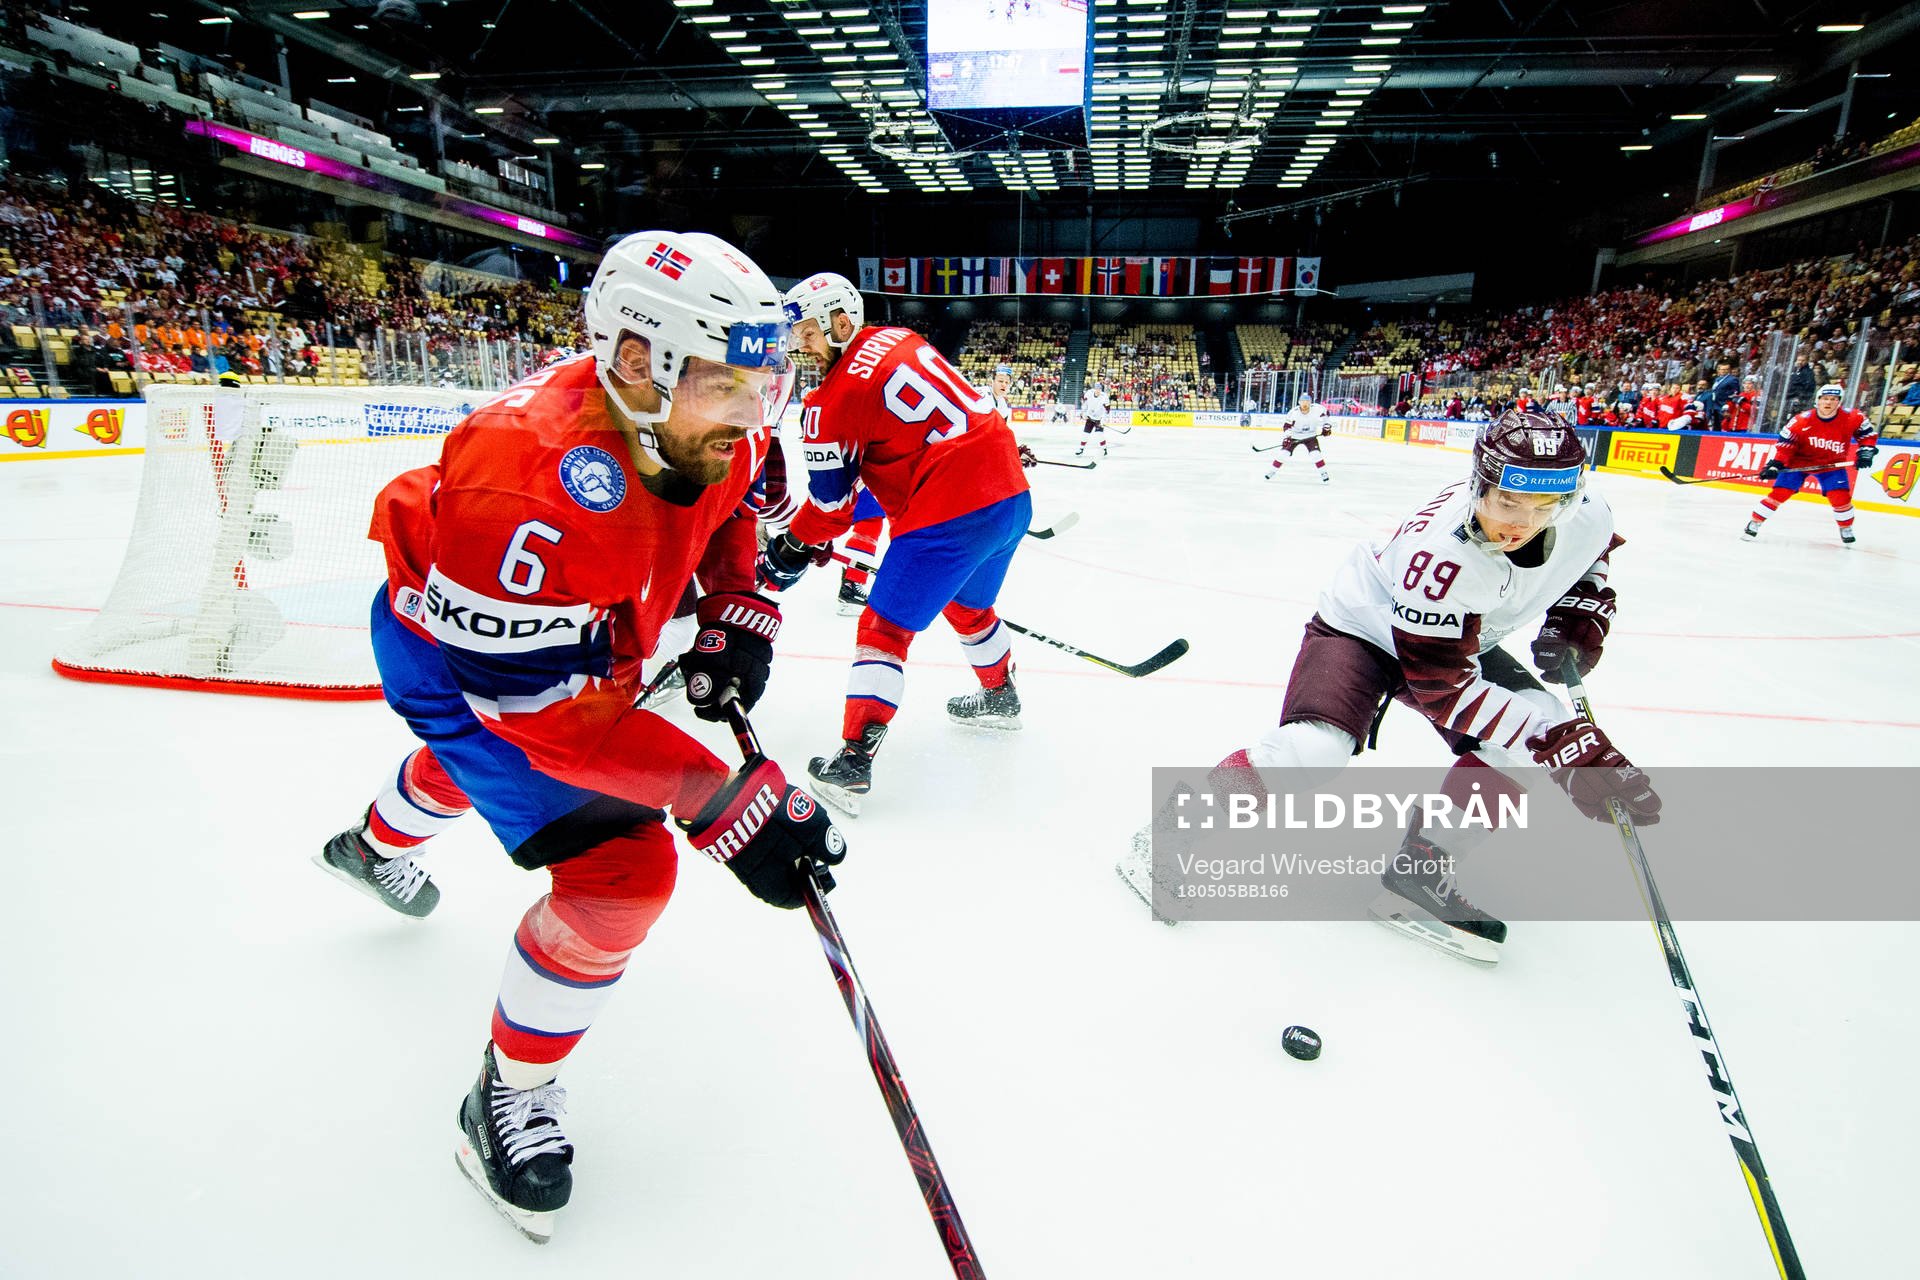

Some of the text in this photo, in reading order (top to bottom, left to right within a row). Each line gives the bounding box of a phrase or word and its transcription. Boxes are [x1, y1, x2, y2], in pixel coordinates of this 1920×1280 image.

[250, 136, 306, 168] HEROES
[620, 305, 661, 328] CCM
[883, 345, 996, 445] 90
[803, 451, 839, 462] ODA
[1532, 438, 1557, 456] 89
[1613, 439, 1671, 465] PIRELLI
[1809, 436, 1846, 454] NORGE
[498, 519, 565, 597] 6
[1403, 550, 1462, 602] 89
[425, 583, 576, 639] ŠKODA
